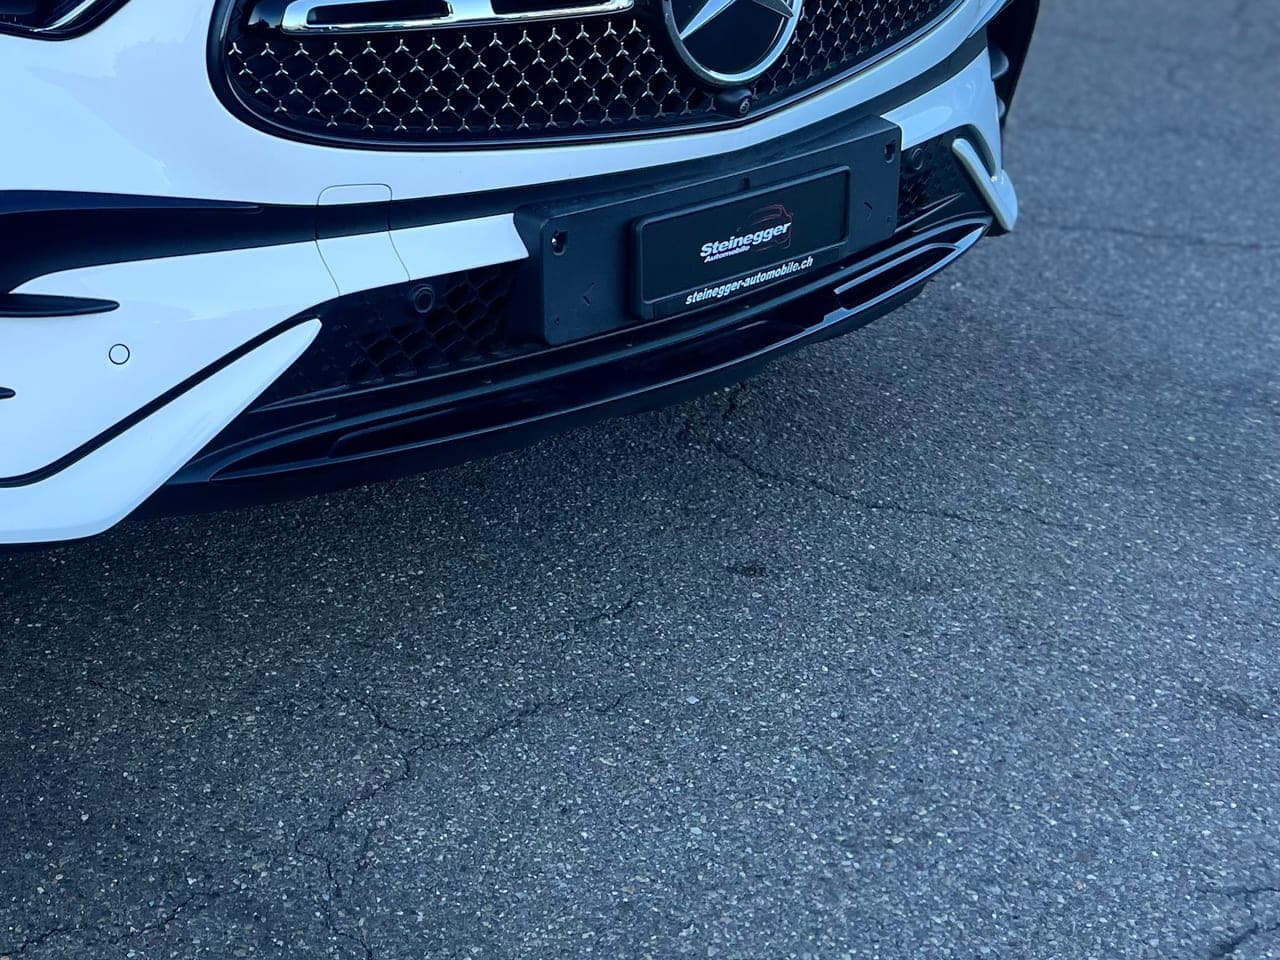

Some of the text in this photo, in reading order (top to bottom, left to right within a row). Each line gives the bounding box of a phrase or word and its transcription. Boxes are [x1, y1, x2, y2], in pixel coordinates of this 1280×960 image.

[700, 222, 792, 257] Steinegger
[704, 245, 751, 263] Automobile
[685, 256, 814, 305] steinegger-automobile.ch
